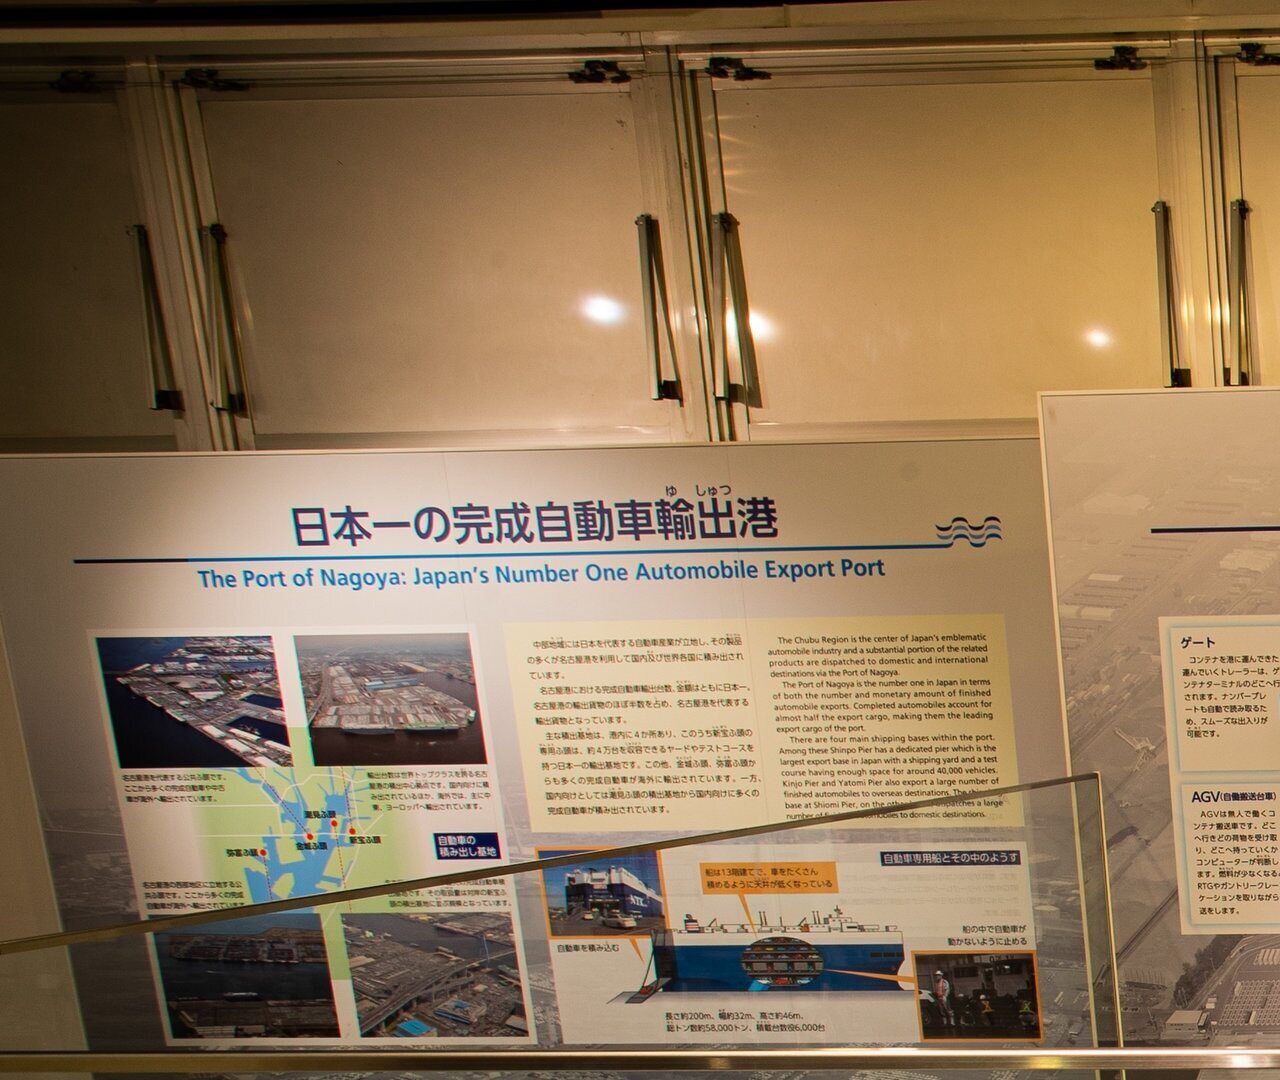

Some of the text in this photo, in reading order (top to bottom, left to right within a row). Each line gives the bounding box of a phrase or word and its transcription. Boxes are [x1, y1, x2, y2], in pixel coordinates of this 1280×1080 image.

[291, 498, 778, 545] 日本一の完成自動車輸出港
[196, 558, 885, 590] The Port of Nagoya: Japan's Number One Automobile Export Port
[1180, 636, 1215, 649] ゲート
[1191, 790, 1223, 803] AGV
